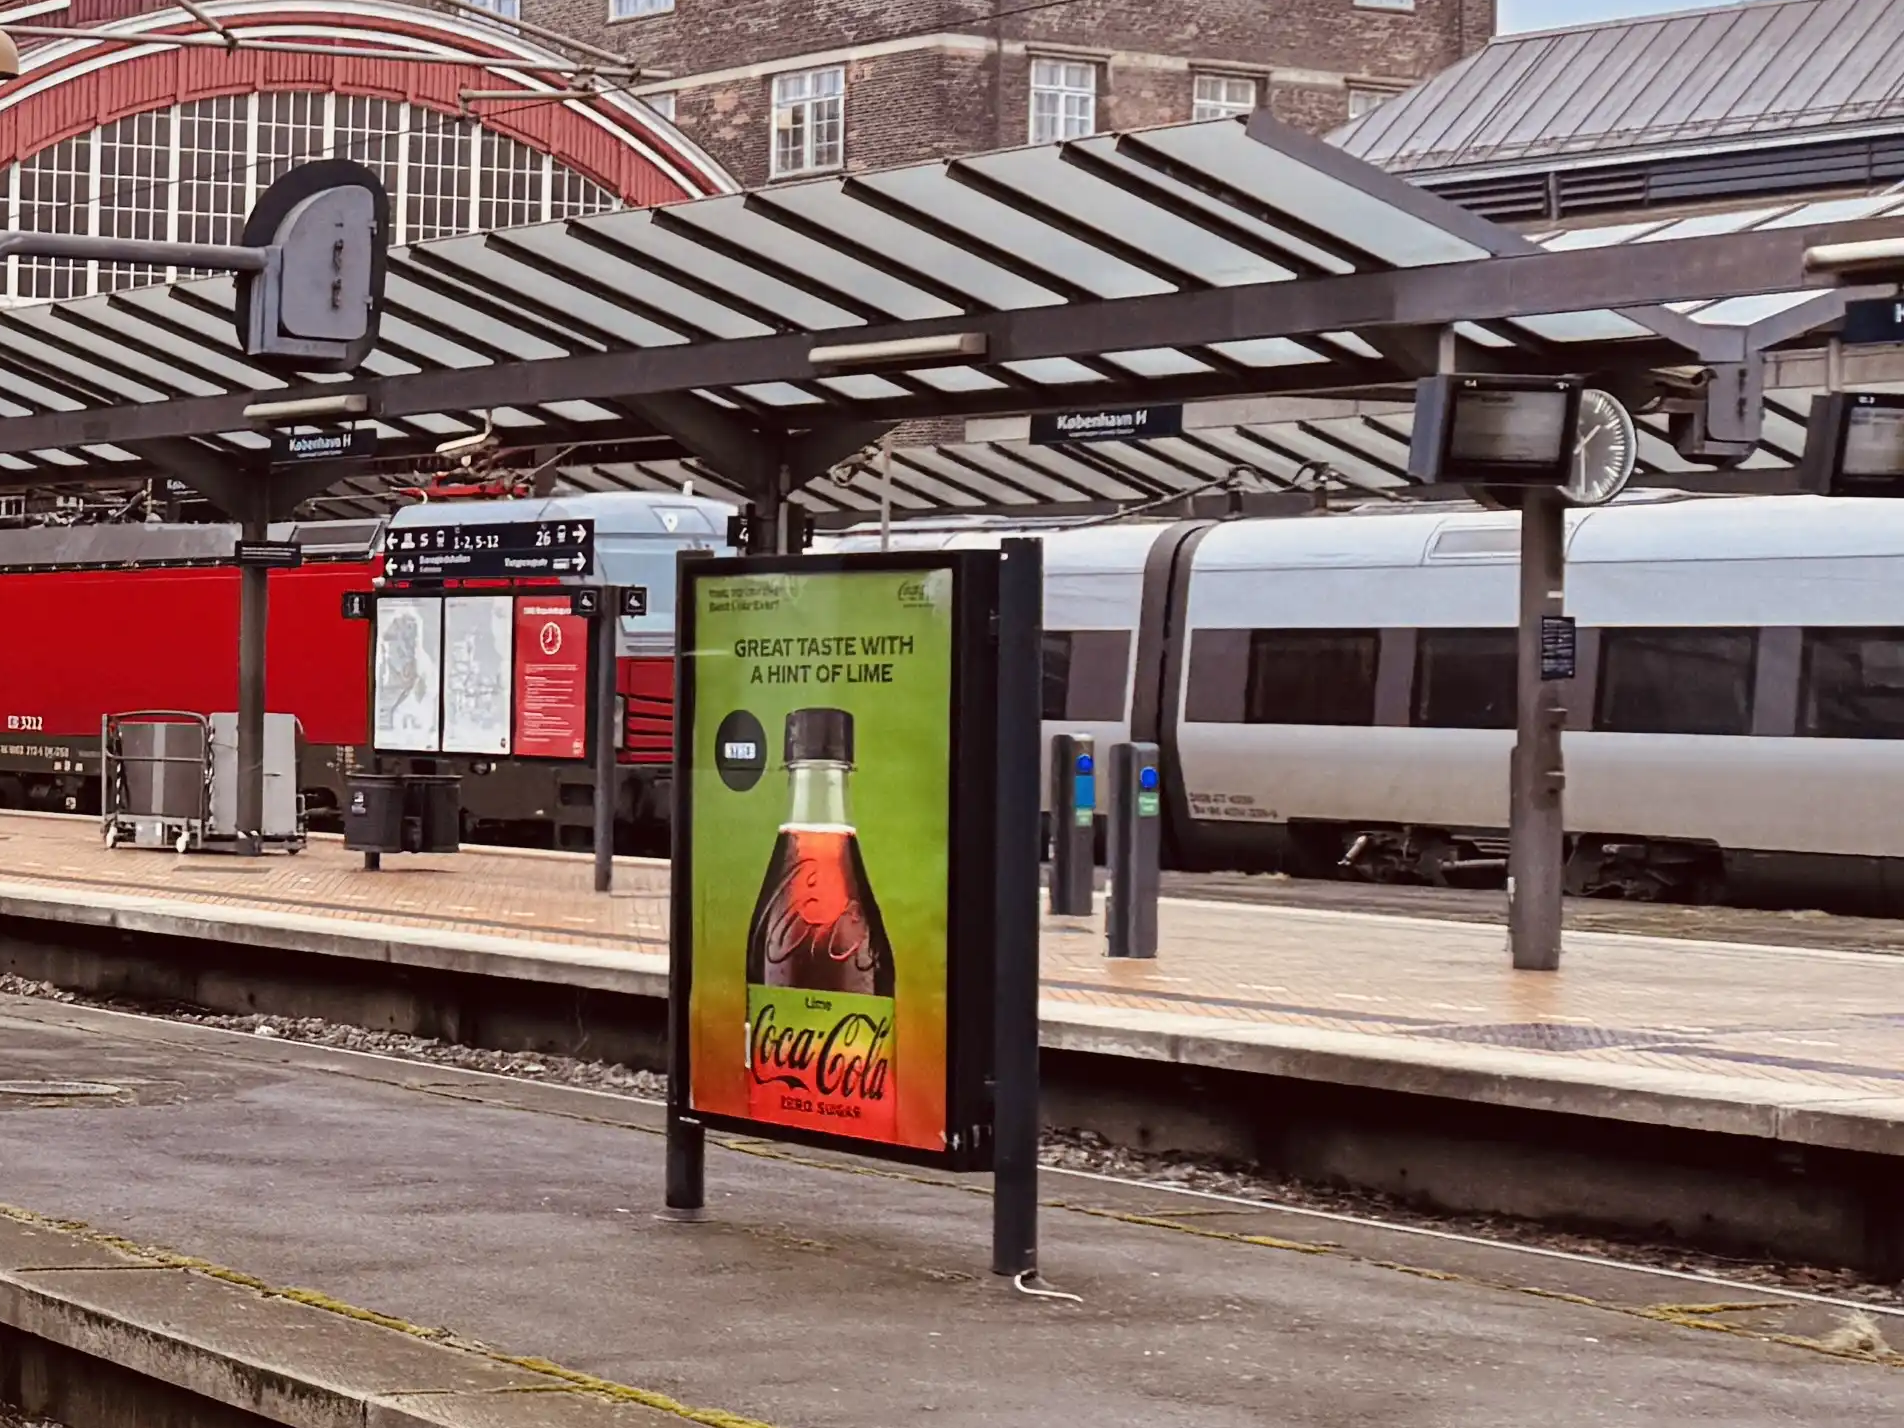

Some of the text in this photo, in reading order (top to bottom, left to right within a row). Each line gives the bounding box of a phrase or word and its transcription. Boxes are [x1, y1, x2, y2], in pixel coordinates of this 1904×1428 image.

[535, 530, 552, 547] 26
[734, 635, 914, 658] GREAT TASTE WITH
[750, 663, 894, 684] A HINT OF LIME
[804, 996, 832, 1011] Lime
[781, 1094, 861, 1119] ZERO SUGAR
